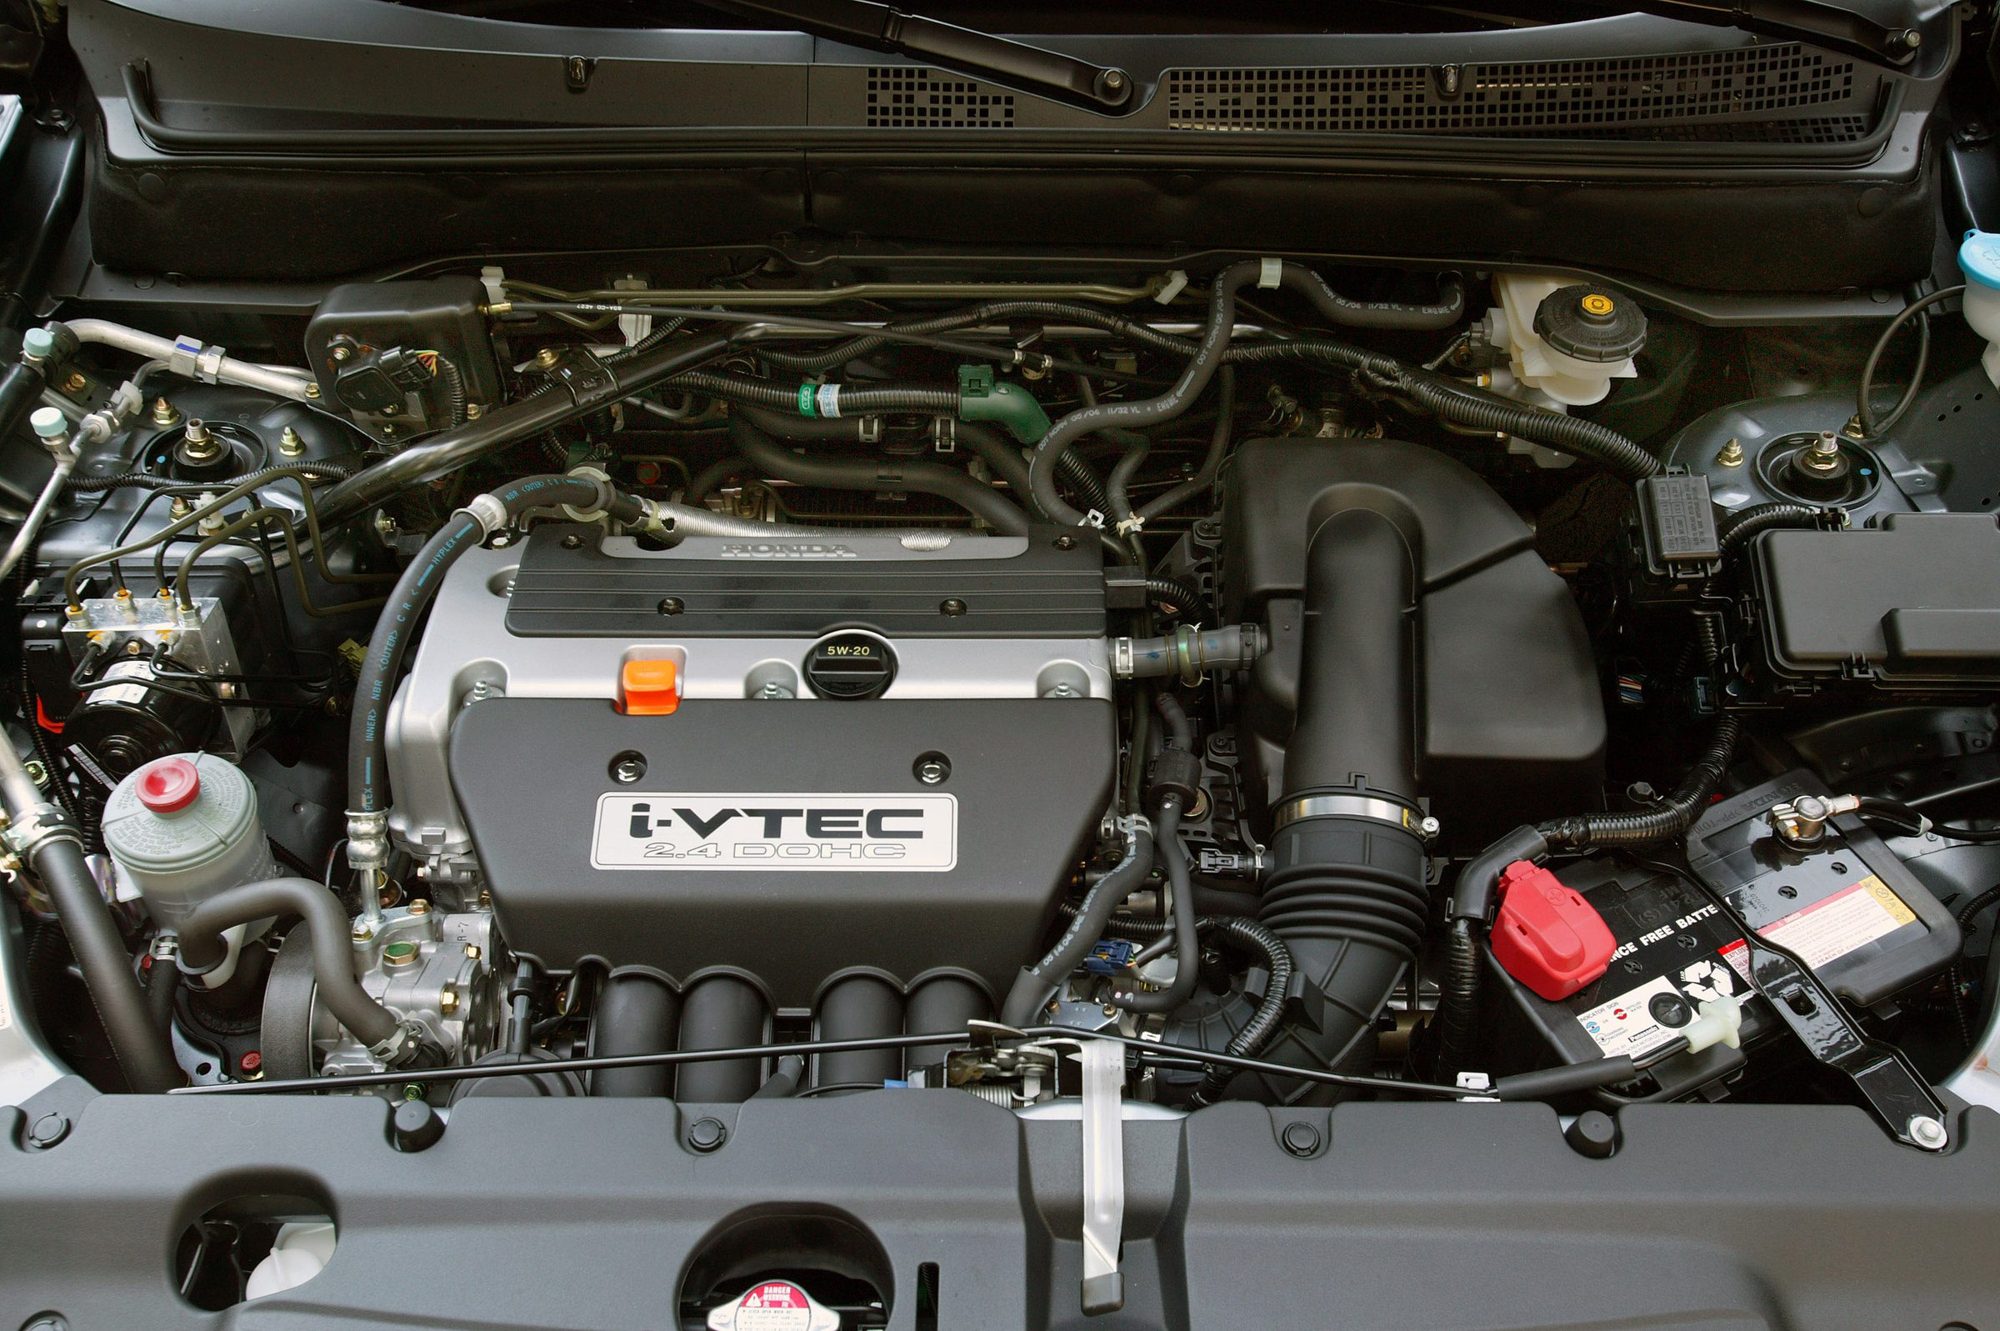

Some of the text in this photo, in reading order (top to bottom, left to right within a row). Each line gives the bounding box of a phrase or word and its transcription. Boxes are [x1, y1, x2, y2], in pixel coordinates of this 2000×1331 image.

[431, 536, 457, 566] HYPLEX
[721, 544, 857, 558] HONDA
[827, 646, 870, 656] 5W-20
[371, 679, 384, 701] NBR
[629, 802, 925, 839] i-VTEC
[643, 842, 906, 859] 2.4 DOHC
[1639, 925, 1675, 946] FREE
[1675, 903, 1719, 930] BATTE
